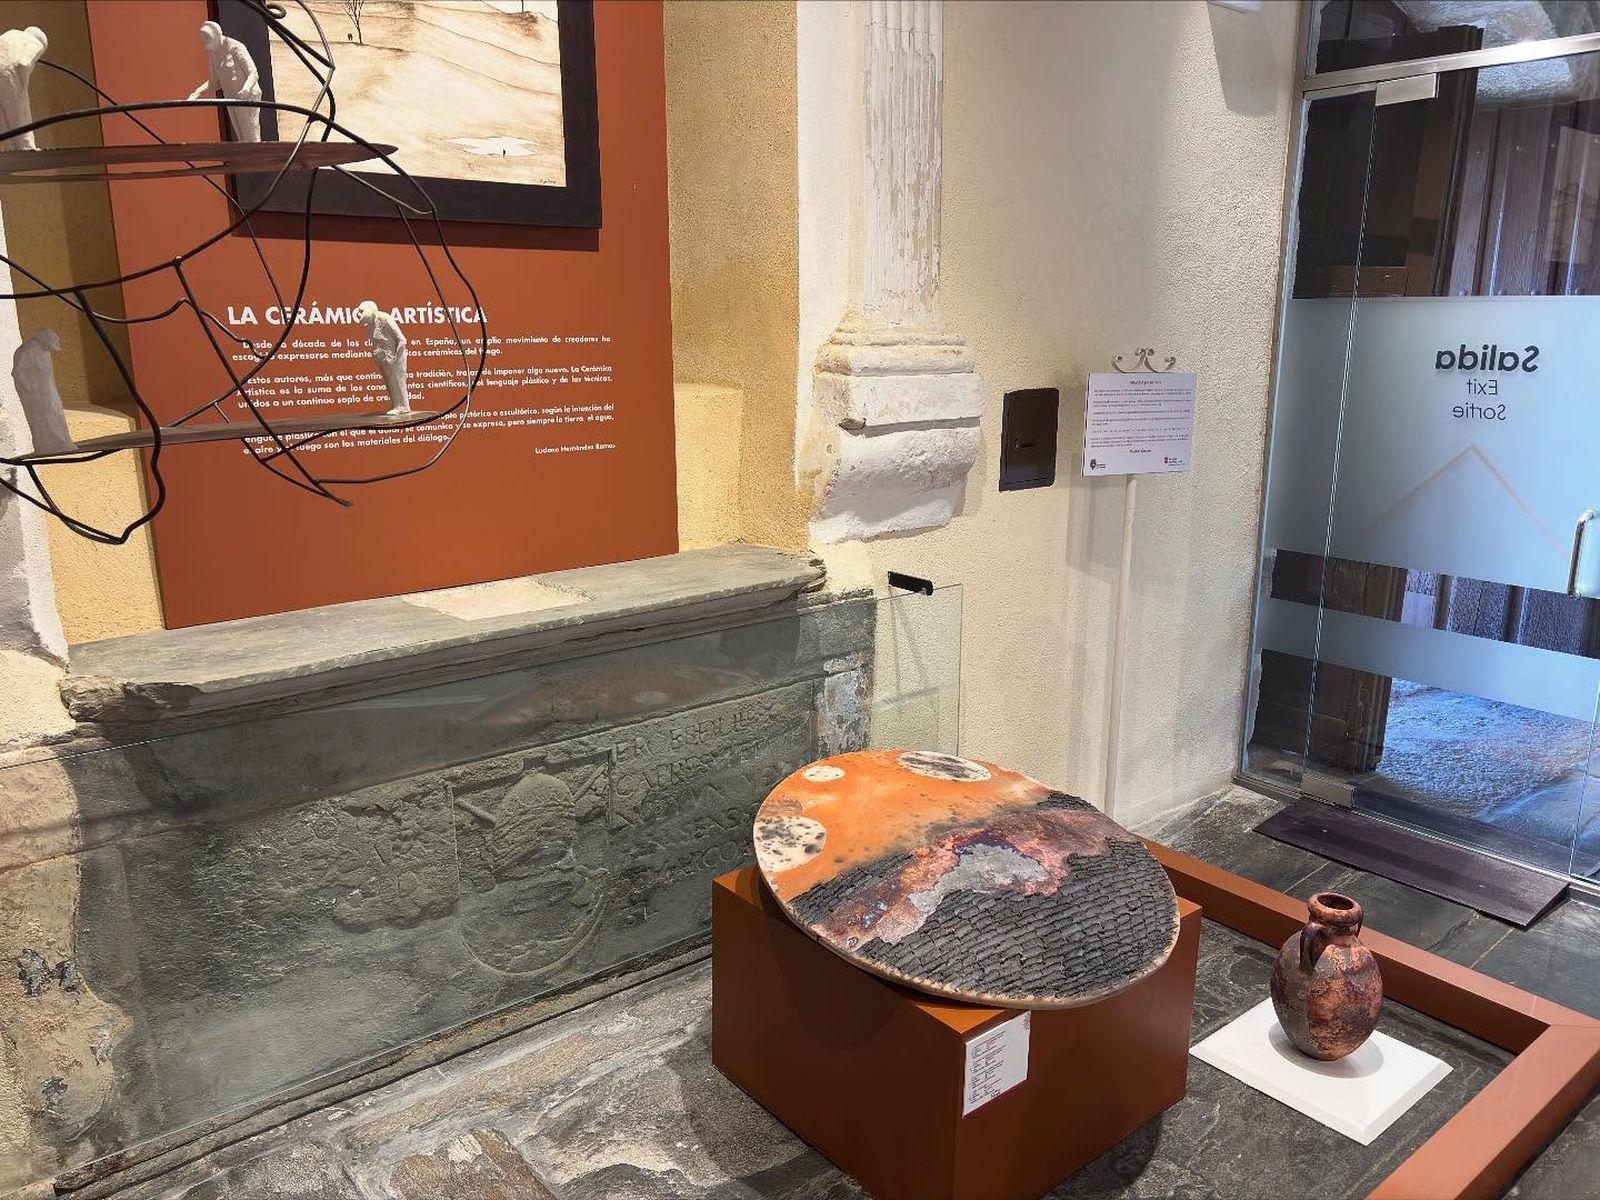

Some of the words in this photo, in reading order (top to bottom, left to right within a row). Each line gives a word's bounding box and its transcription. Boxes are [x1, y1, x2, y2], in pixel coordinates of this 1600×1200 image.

[227, 306, 258, 325] LA
[265, 301, 366, 325] CERÁMIC
[390, 300, 487, 324] ARTÍSTICA
[242, 339, 272, 349] Dsde
[292, 339, 326, 348] década
[331, 339, 342, 348] de
[347, 339, 359, 347] los
[425, 338, 457, 347] España,
[506, 336, 549, 344] movimiento
[565, 335, 598, 343] creadores
[232, 352, 275, 362] escog
[277, 352, 329, 361] expresarse
[331, 350, 372, 359] mediante
[423, 348, 462, 357] cerámicas
[465, 347, 477, 355] del
[479, 347, 503, 356] fego.
[274, 375, 311, 384] autores,
[315, 373, 334, 382] más
[417, 369, 453, 378] tradición,
[493, 367, 524, 377] imponer
[527, 366, 542, 375] algo
[294, 386, 303, 394] la
[335, 384, 346, 392] de
[350, 383, 363, 391] los
[521, 376, 549, 386] plástico
[238, 399, 271, 408] undos
[296, 397, 335, 406] continuo
[337, 395, 361, 404] soplo
[363, 394, 374, 402] de
[459, 410, 491, 420] pctórico
[541, 406, 563, 415] según
[563, 405, 571, 413] la
[603, 403, 614, 411] del
[350, 429, 367, 437] que
[416, 422, 453, 431] comunica
[526, 417, 555, 426] siempre
[556, 415, 563, 423] la
[255, 446, 274, 454] aire
[342, 440, 355, 448] los
[357, 437, 400, 447] materiales
[403, 435, 415, 443] del
